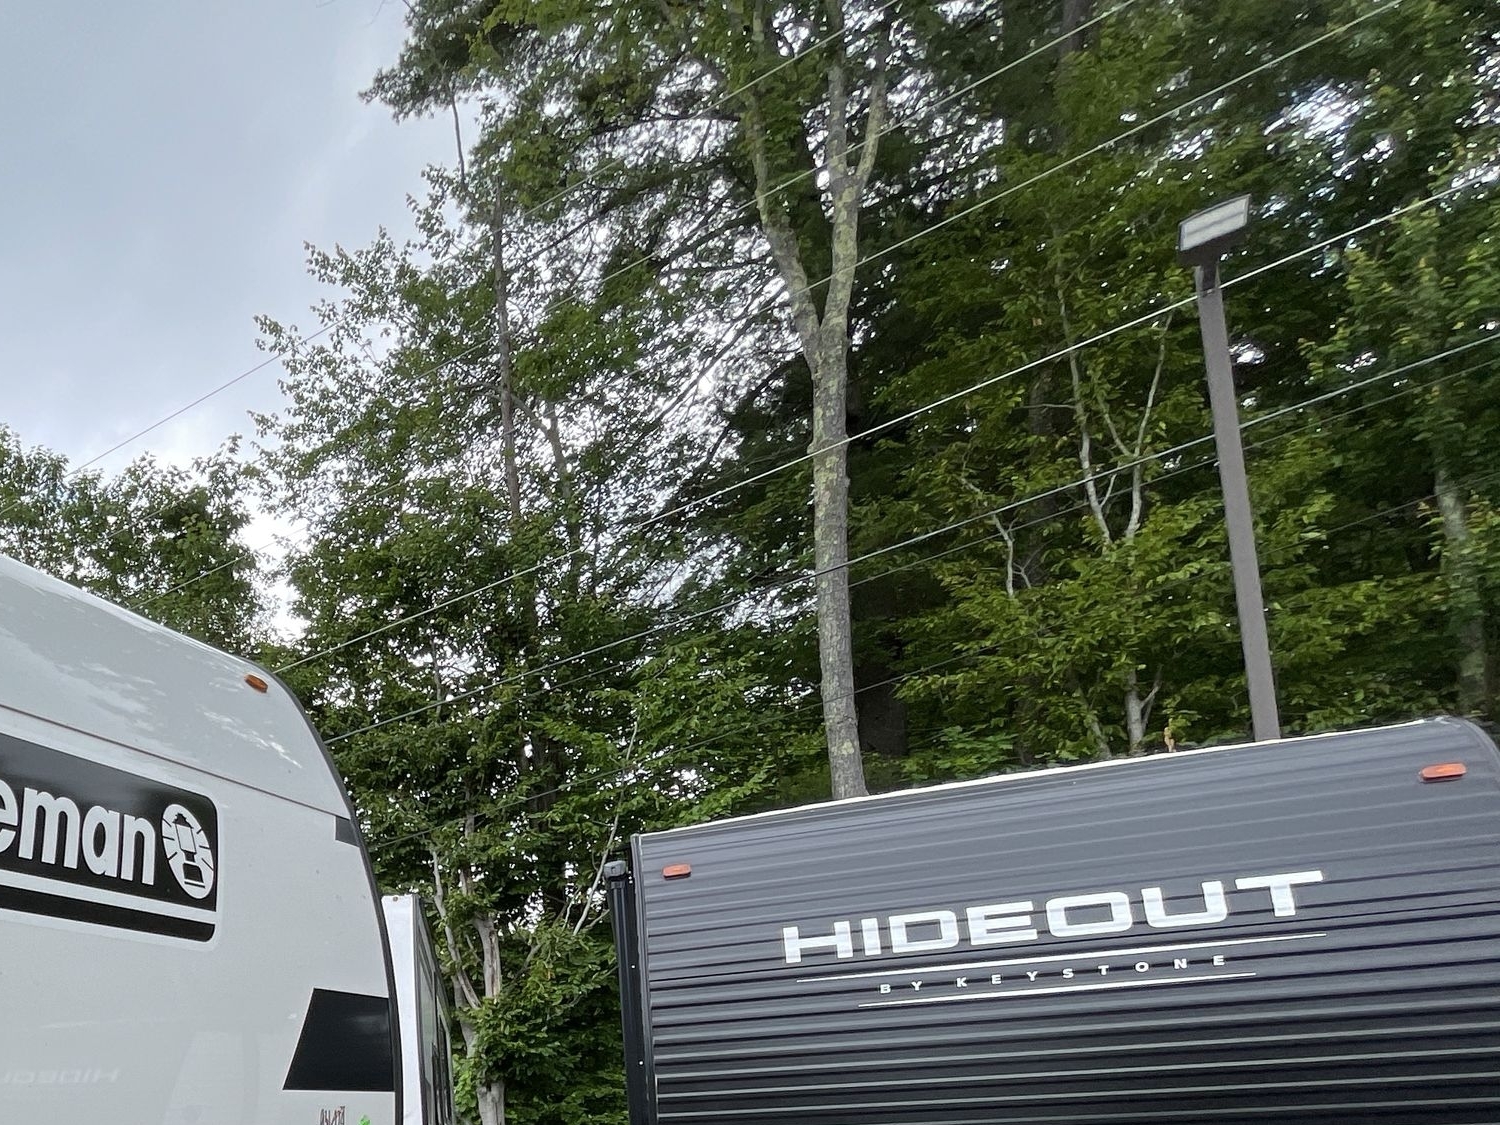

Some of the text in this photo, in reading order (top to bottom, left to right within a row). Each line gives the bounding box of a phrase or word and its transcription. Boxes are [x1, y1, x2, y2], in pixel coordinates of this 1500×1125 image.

[783, 870, 1323, 963] HIDEOUT
[879, 955, 1225, 994] BY KEYSTONE
